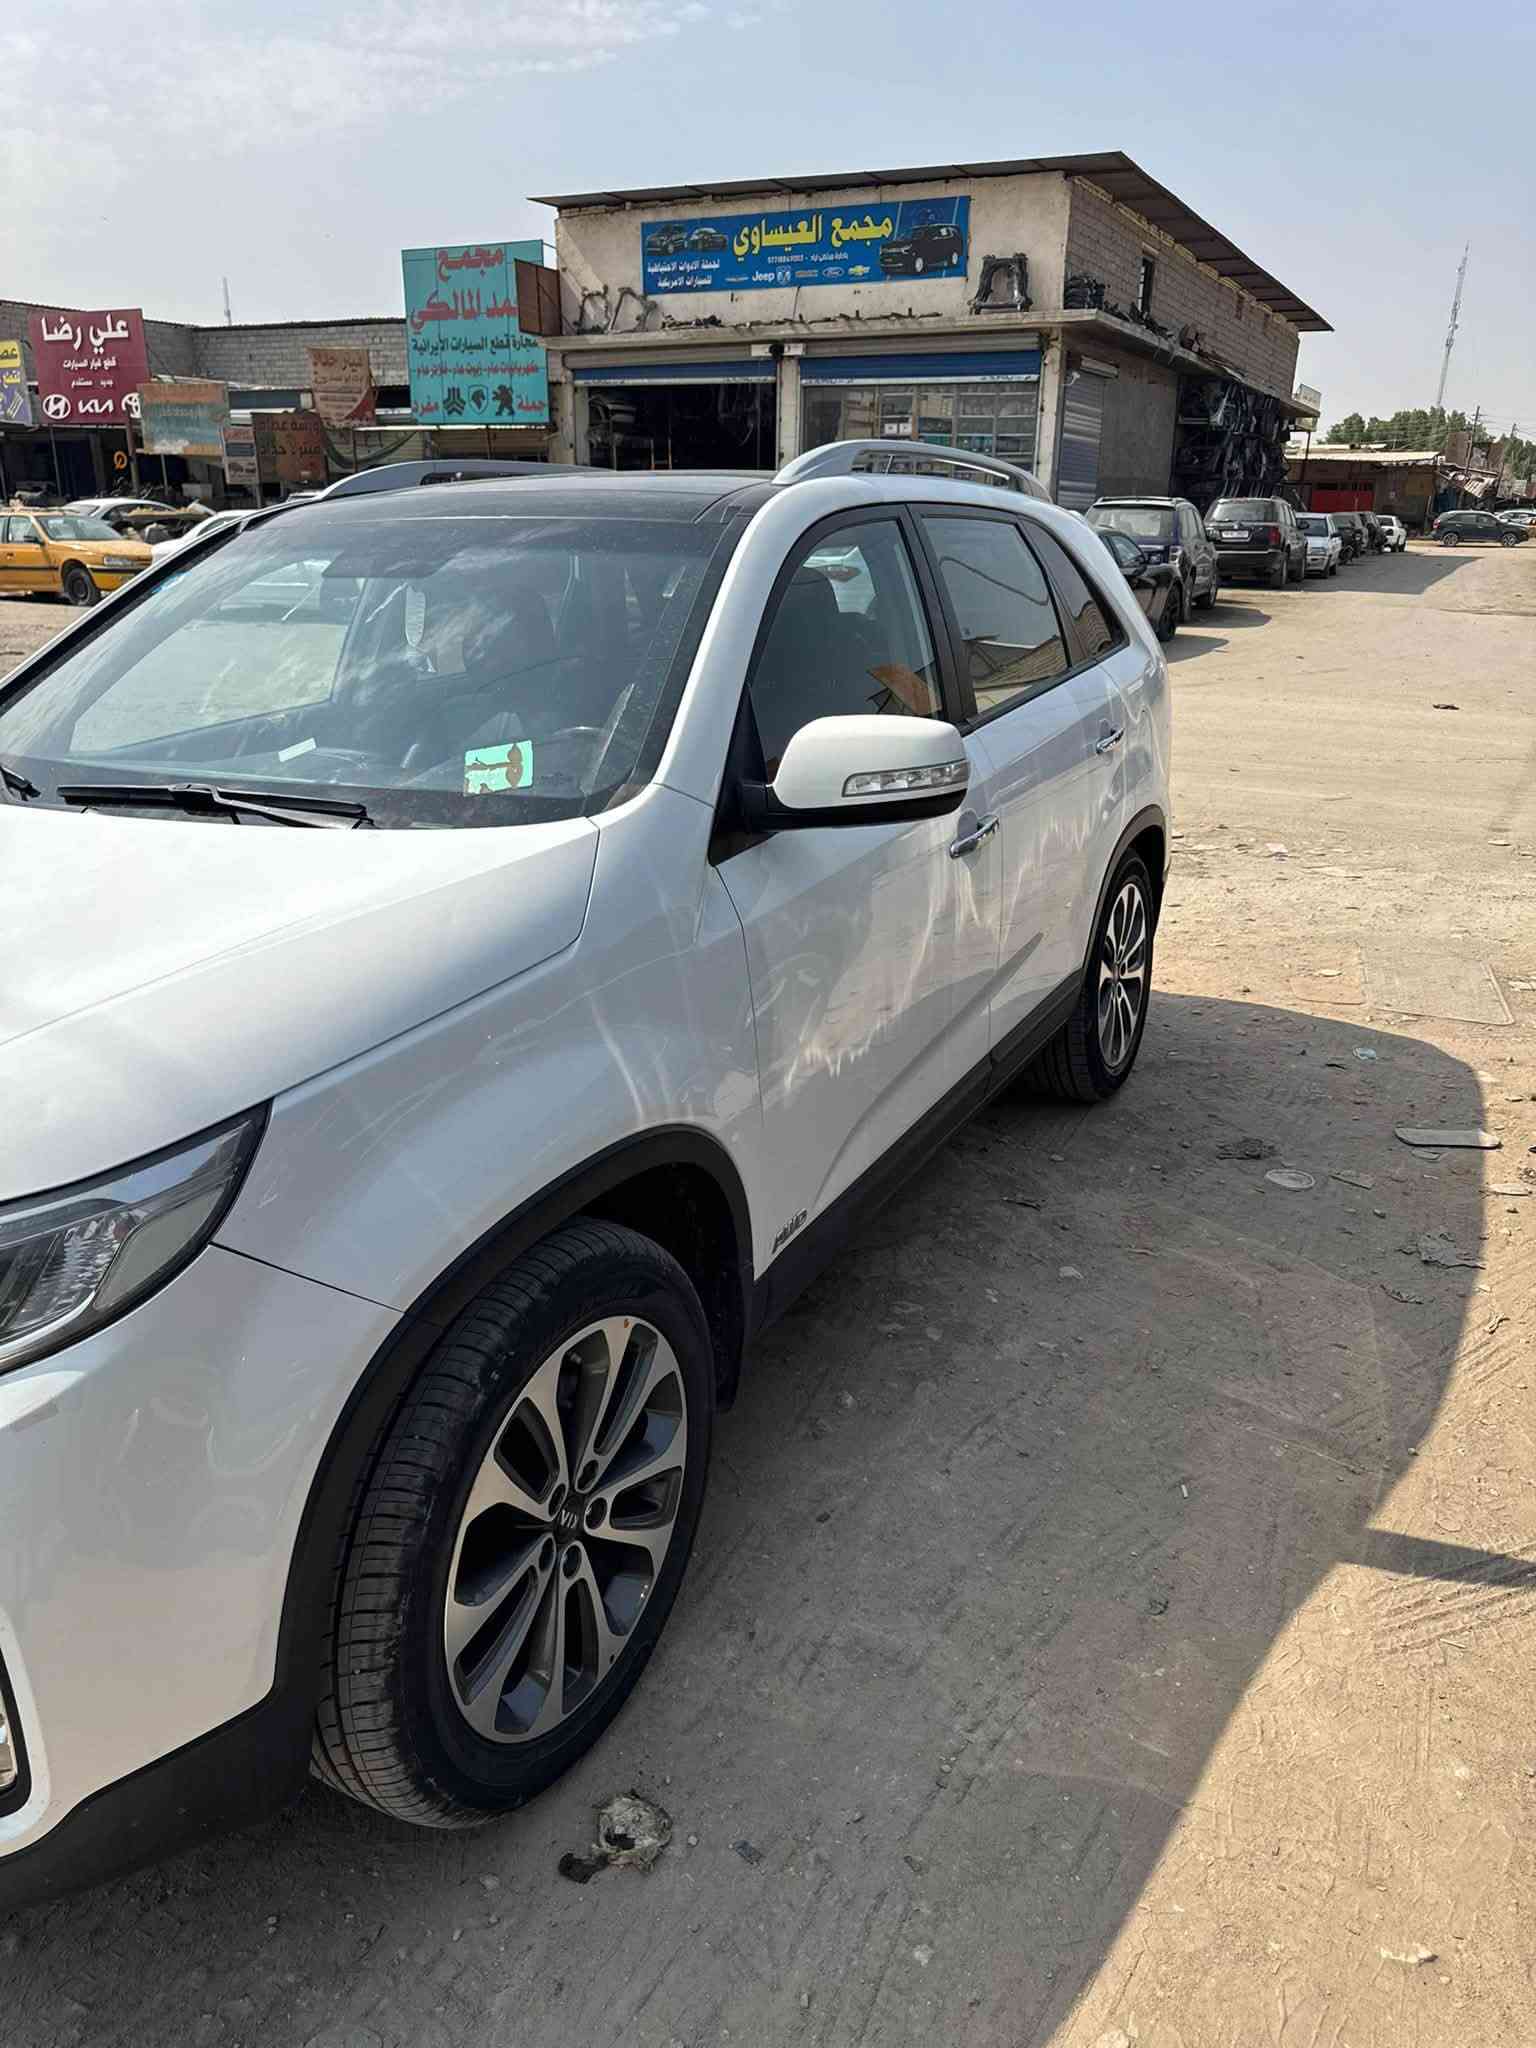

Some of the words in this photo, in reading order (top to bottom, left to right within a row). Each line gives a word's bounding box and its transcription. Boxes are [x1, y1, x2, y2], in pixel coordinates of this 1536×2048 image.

[733, 213, 822, 262] العيساوي
[831, 214, 893, 248] مجمع
[437, 247, 504, 283] مجمع
[751, 270, 775, 283] Jeep
[41, 316, 82, 351] رضا
[89, 313, 129, 354] علي
[451, 335, 488, 354] السيارات
[63, 357, 89, 370] السيارات
[102, 356, 117, 370] قطع
